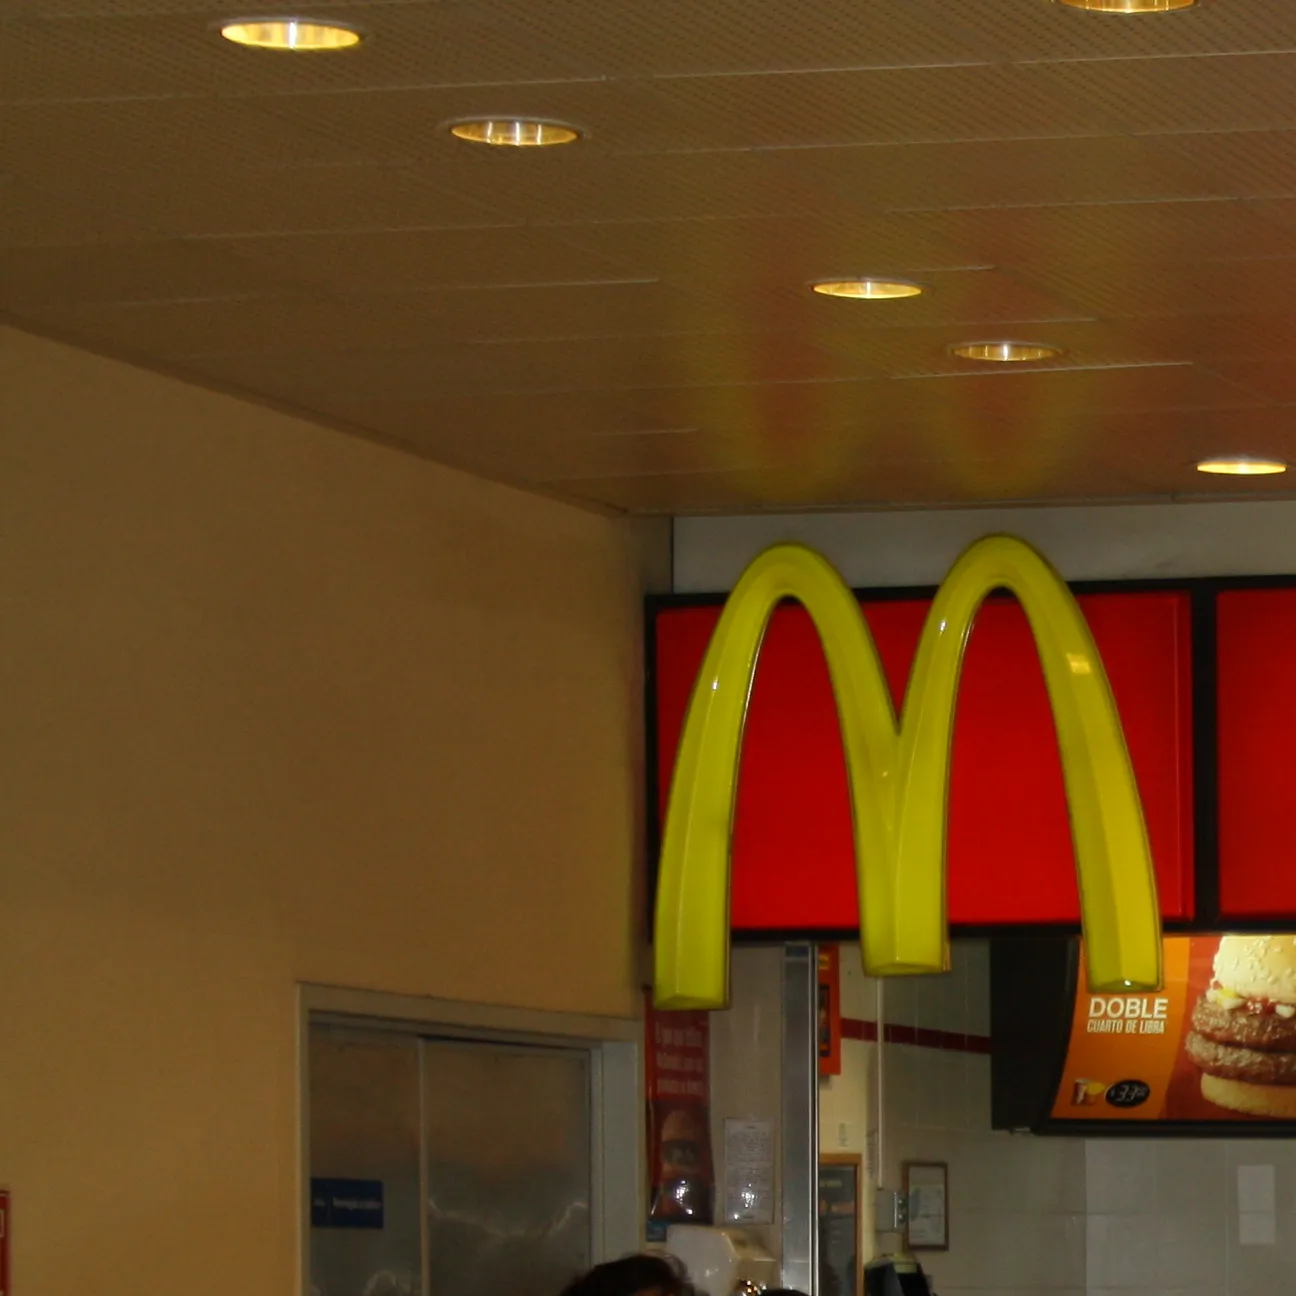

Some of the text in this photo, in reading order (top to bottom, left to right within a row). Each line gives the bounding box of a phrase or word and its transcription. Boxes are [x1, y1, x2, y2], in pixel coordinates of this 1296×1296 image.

[1088, 997, 1169, 1019] DOBLE
[1087, 1019, 1165, 1034] CUARTO DE LIBRA
